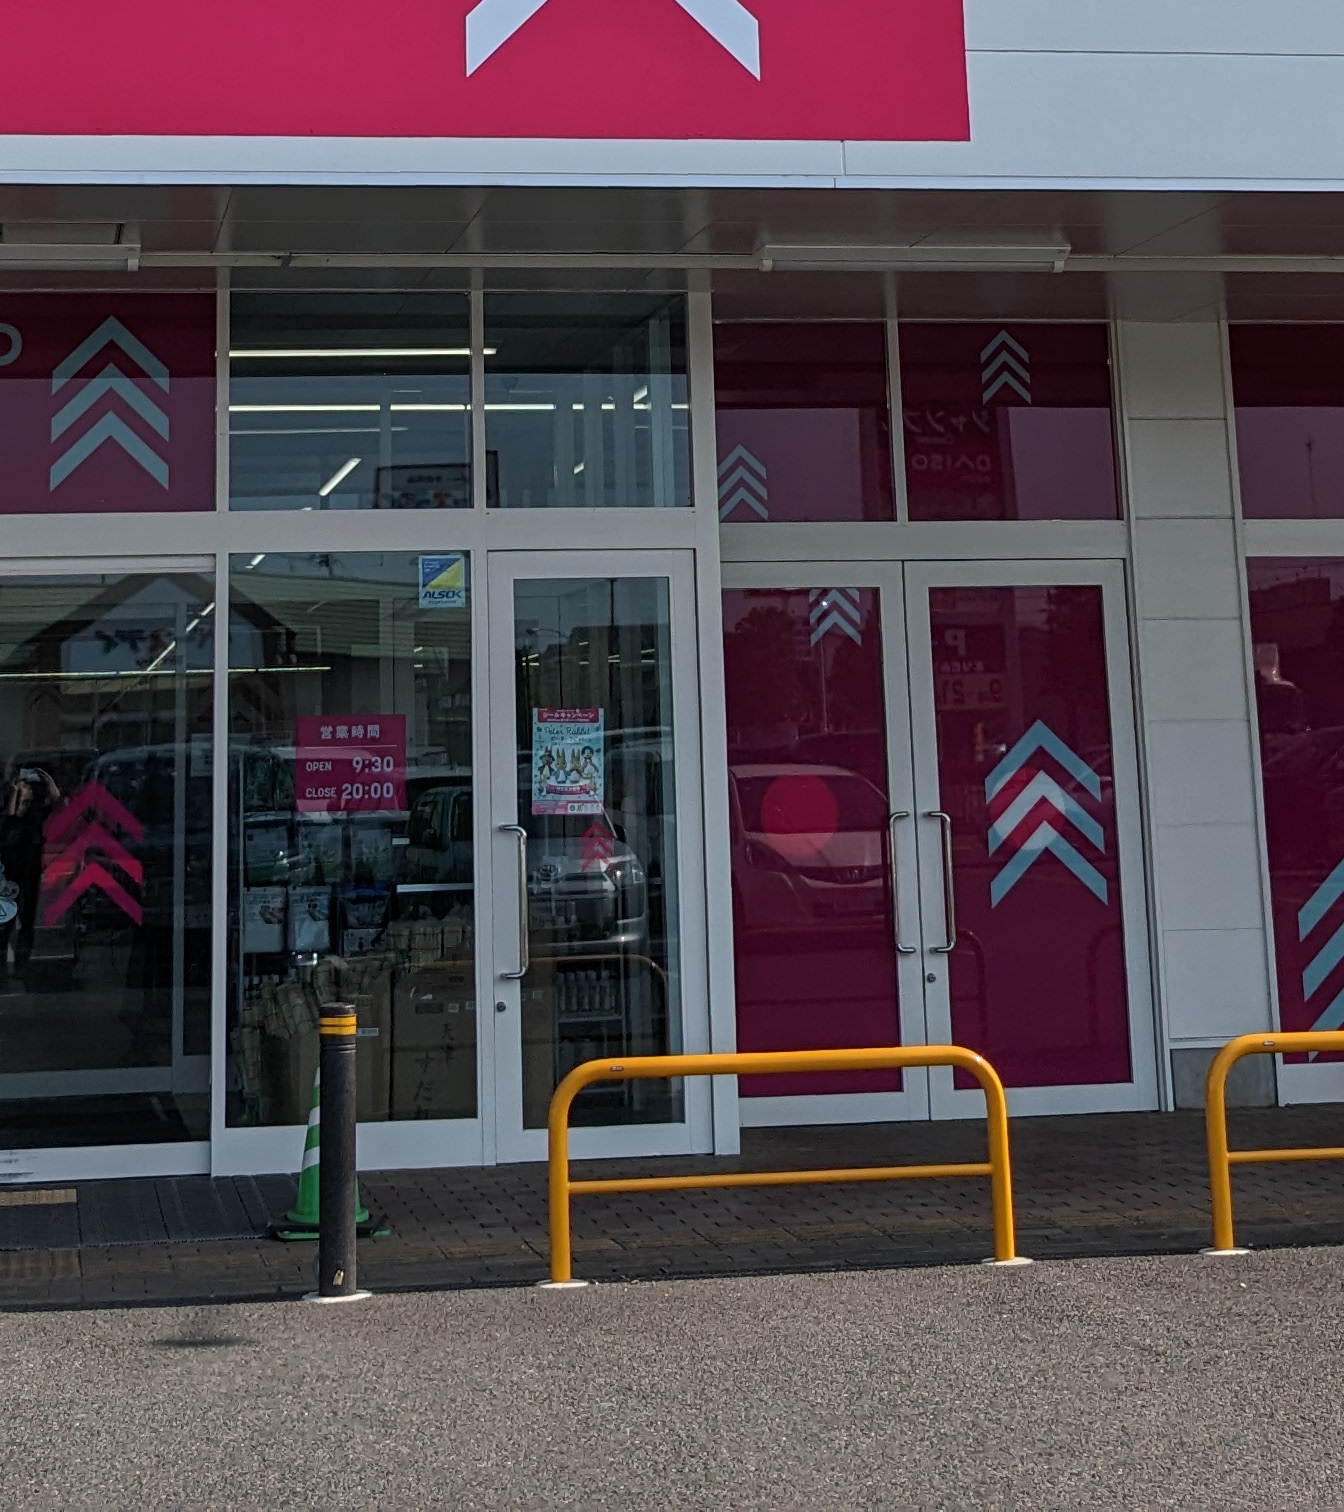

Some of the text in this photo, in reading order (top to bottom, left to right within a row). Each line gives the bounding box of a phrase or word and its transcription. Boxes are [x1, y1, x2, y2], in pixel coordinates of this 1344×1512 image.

[422, 590, 462, 600] ALSOK
[320, 724, 380, 739] 営業時間
[305, 756, 394, 773] OPEN 9:30
[305, 782, 394, 799] CLOSE 20:00
